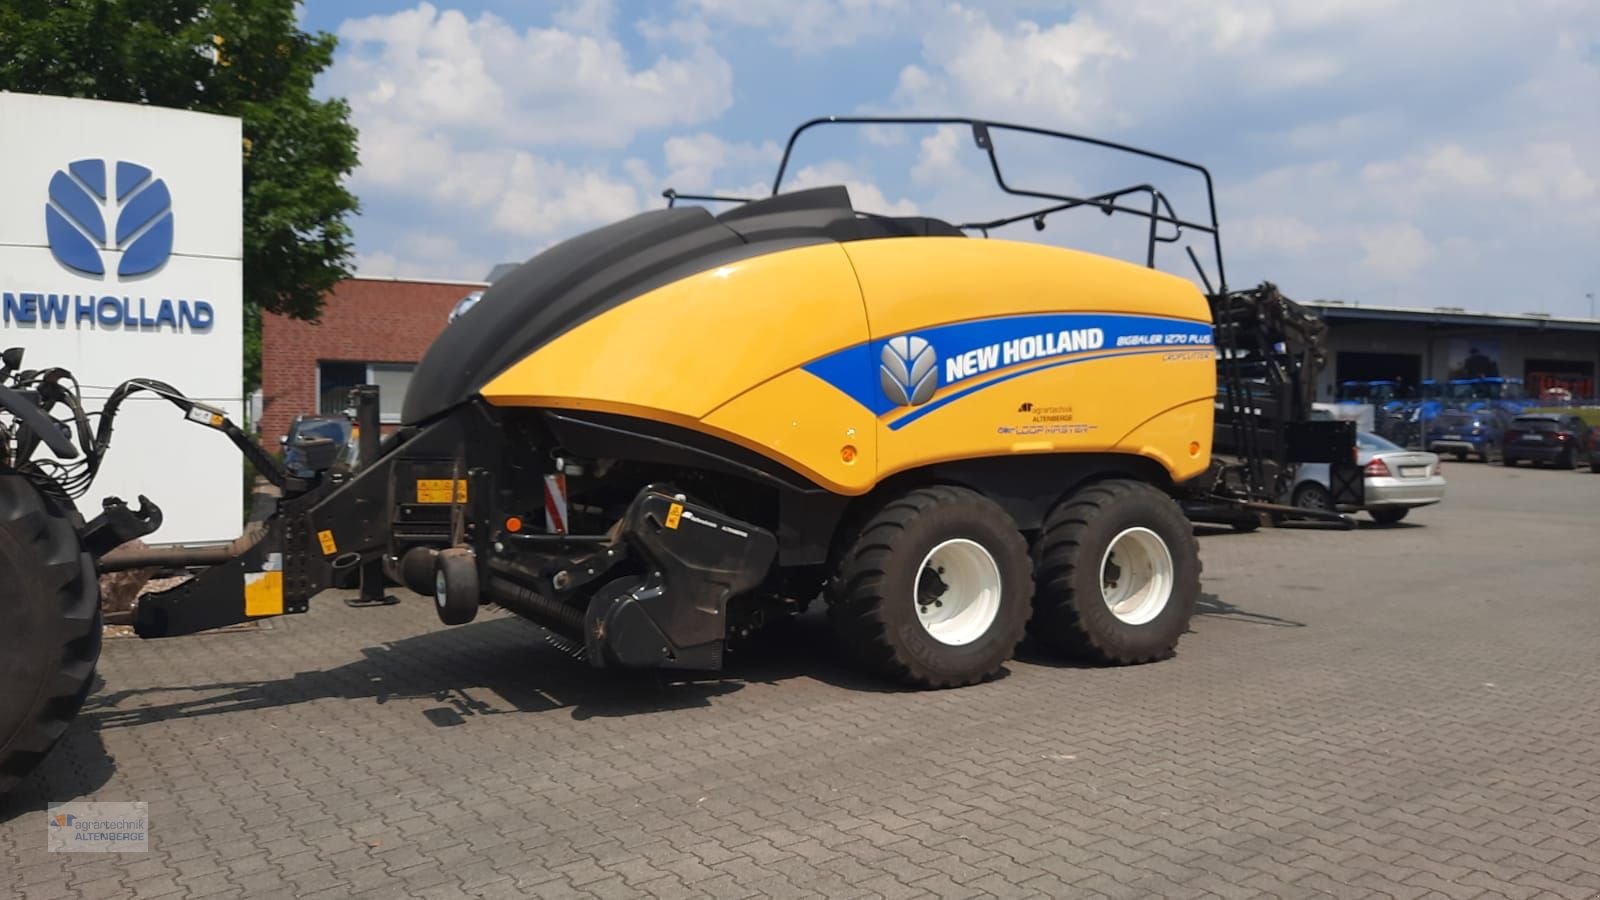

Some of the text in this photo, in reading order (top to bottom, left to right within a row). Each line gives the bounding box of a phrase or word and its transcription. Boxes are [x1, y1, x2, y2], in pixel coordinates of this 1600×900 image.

[3, 293, 214, 330] NEW HOLLAND
[946, 328, 1104, 382] NEW HOLLAND
[1116, 334, 1211, 346] BIGBALER 1270 PLUS
